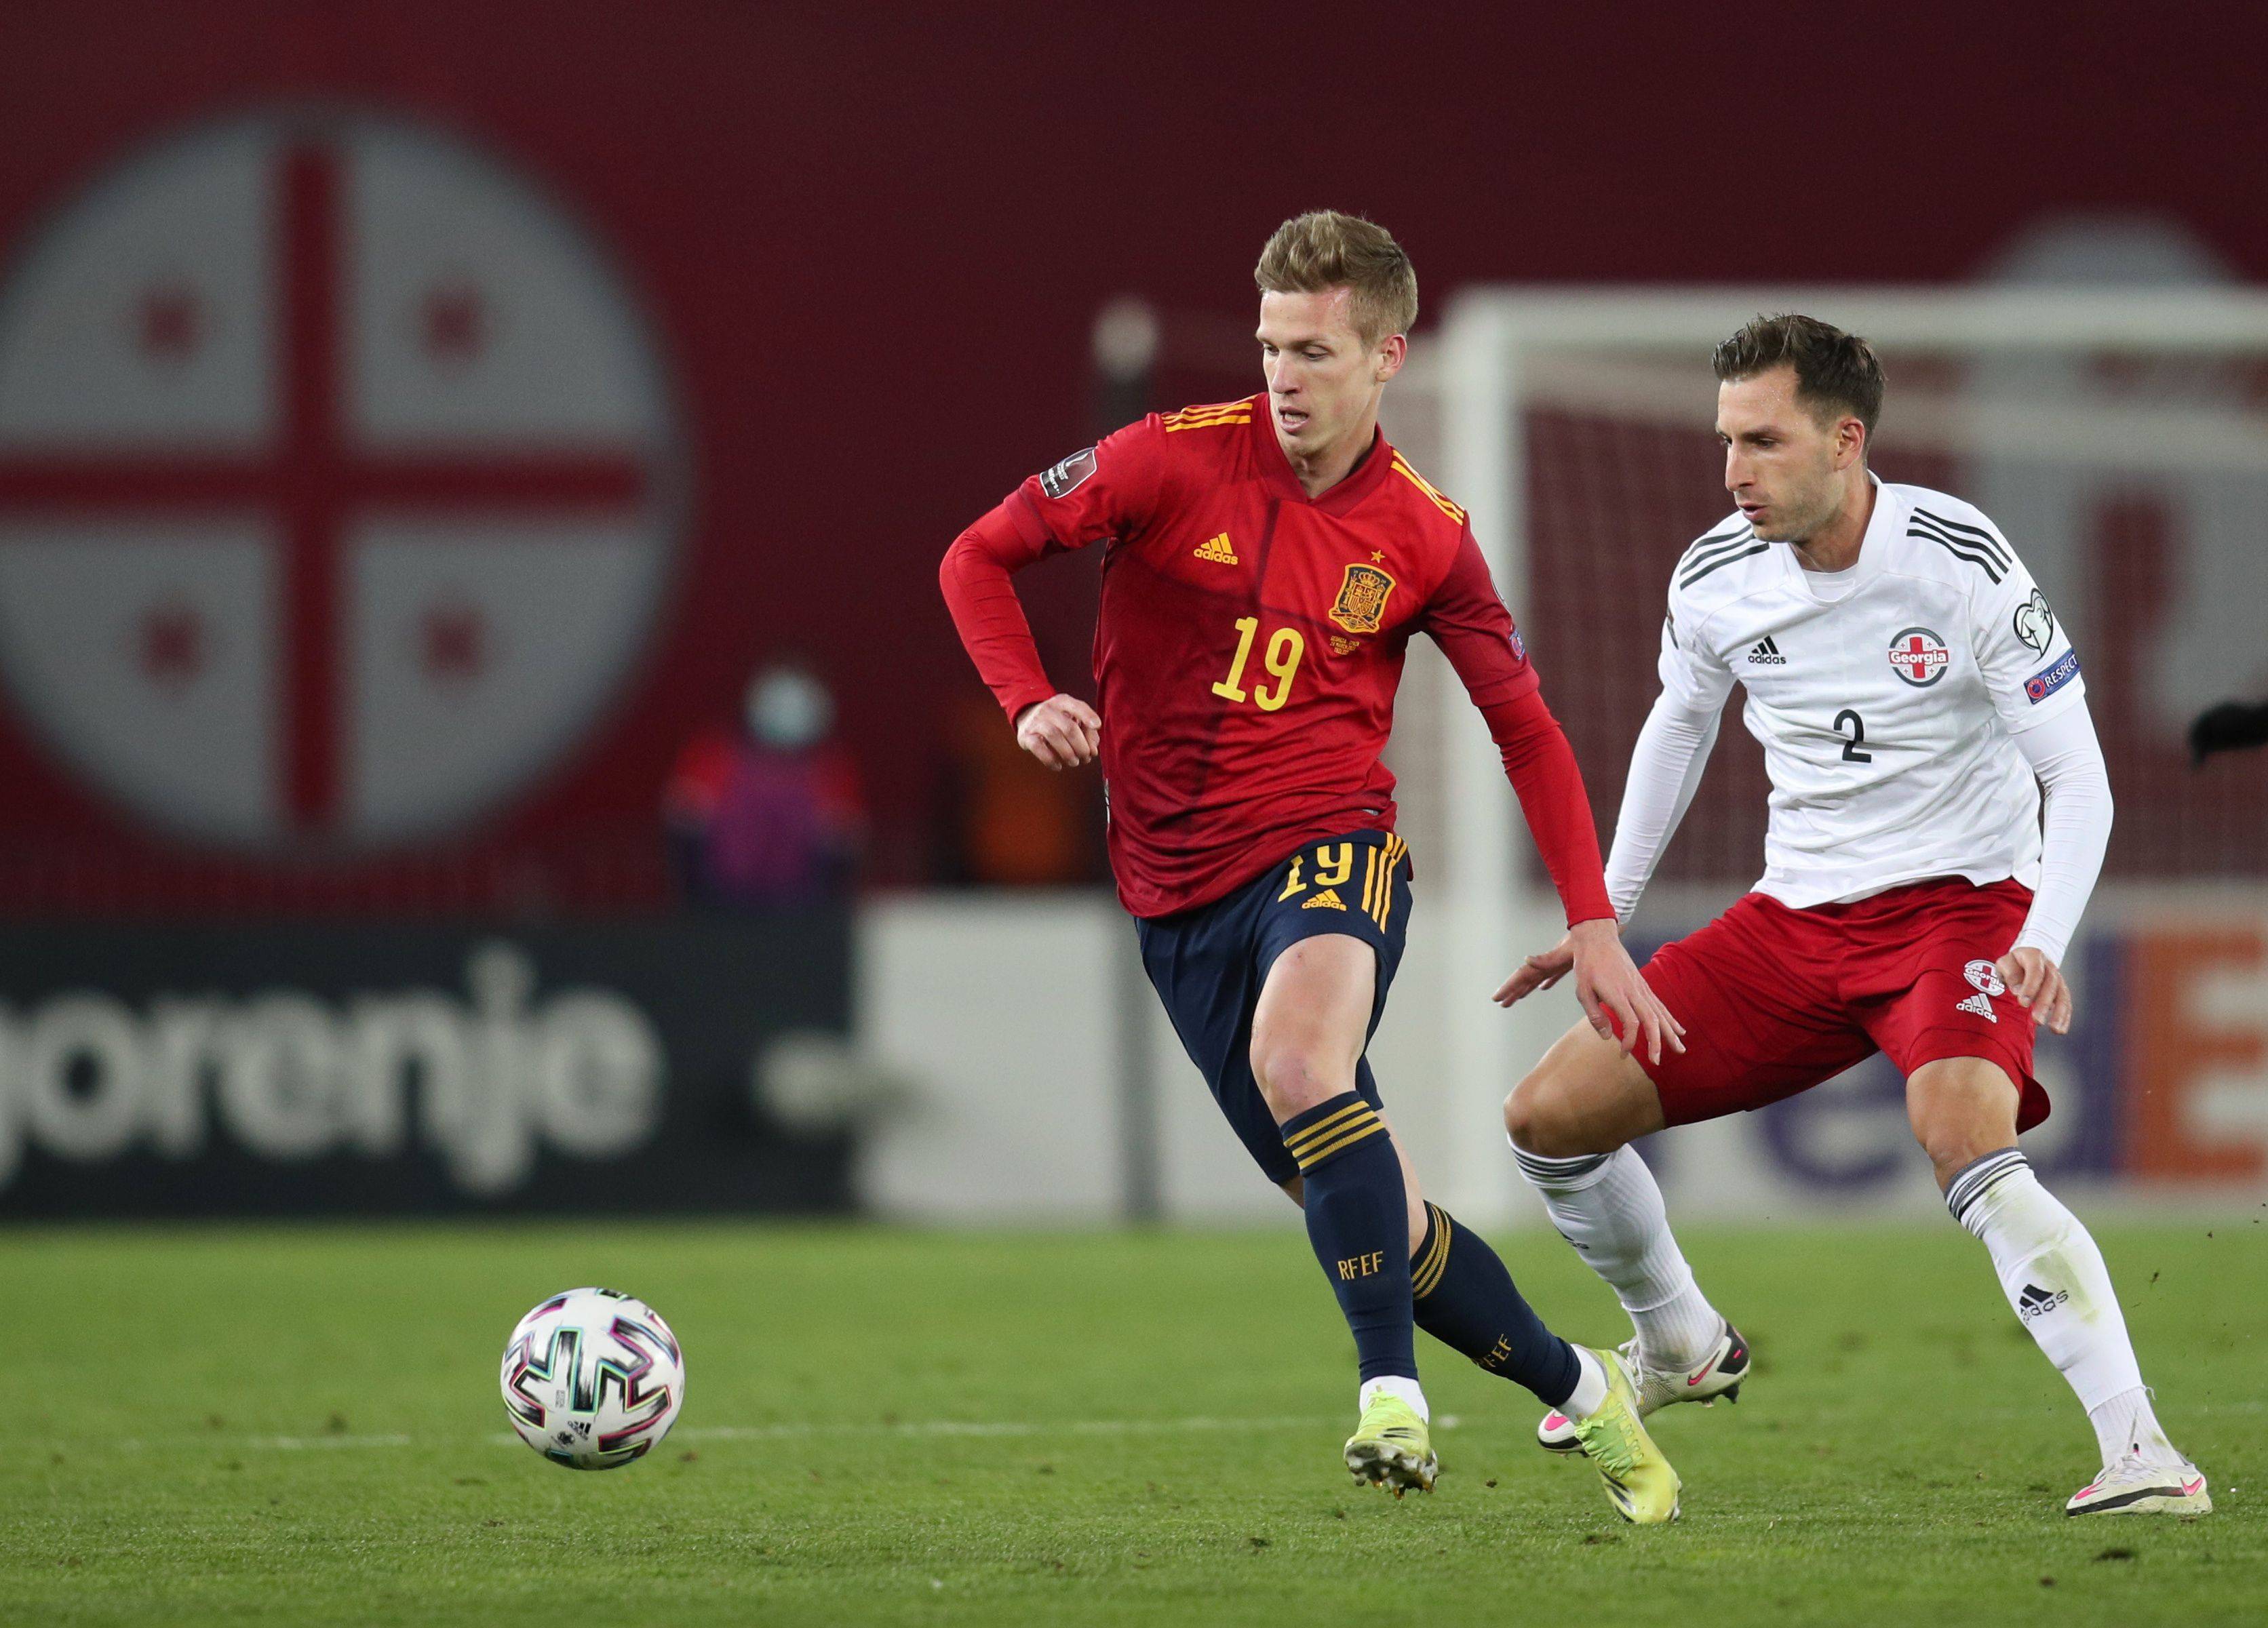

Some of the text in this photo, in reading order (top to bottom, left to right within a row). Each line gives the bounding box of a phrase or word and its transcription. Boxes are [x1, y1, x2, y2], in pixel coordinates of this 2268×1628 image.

[1194, 548, 1238, 565] adidas
[1212, 616, 1304, 711] 19
[1748, 654, 1786, 664] adidas
[1890, 650, 1947, 665] Georgia
[2044, 654, 2077, 688] RESPECT
[1833, 709, 1872, 763] 2
[1302, 900, 1347, 911] adidas
[1965, 968, 2006, 989] Georgia
[1956, 1003, 1997, 1023] adidas
[0, 937, 666, 1195] orenje
[1337, 1250, 1384, 1280] RFEF
[1473, 1333, 1512, 1367] FEF
